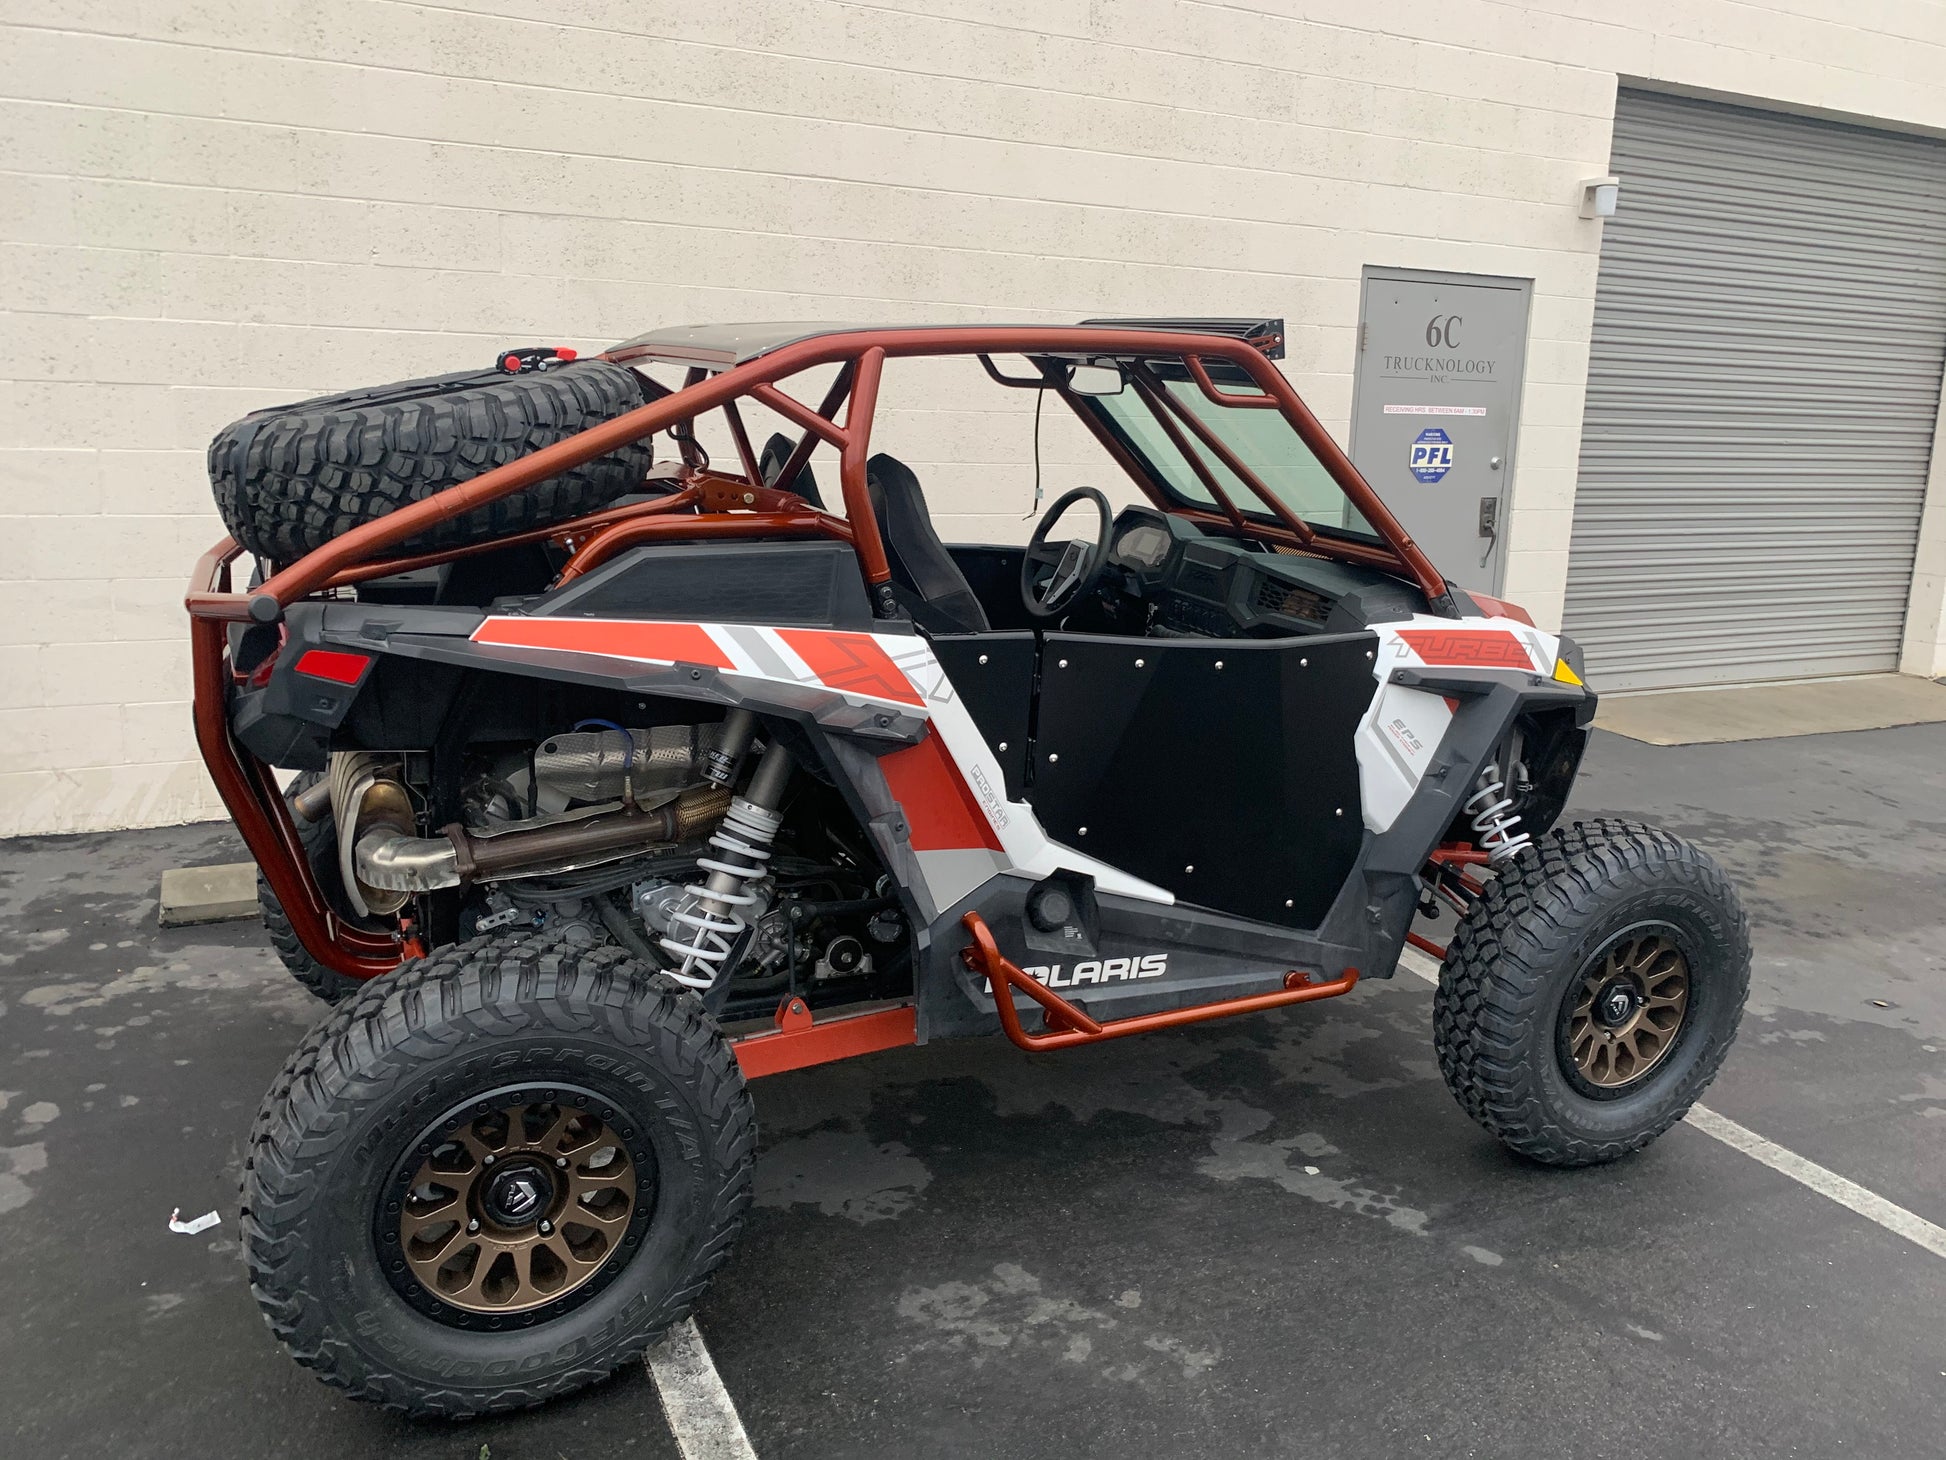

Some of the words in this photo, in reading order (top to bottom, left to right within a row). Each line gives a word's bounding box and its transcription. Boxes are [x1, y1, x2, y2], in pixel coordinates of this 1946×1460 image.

[1426, 314, 1463, 349] 6C
[1384, 355, 1496, 374] TRUCKNOLOGY
[1412, 448, 1451, 464] PFL
[1387, 636, 1534, 664] TURBO
[1393, 719, 1423, 750] EPS
[972, 766, 1009, 829] PROSTAR
